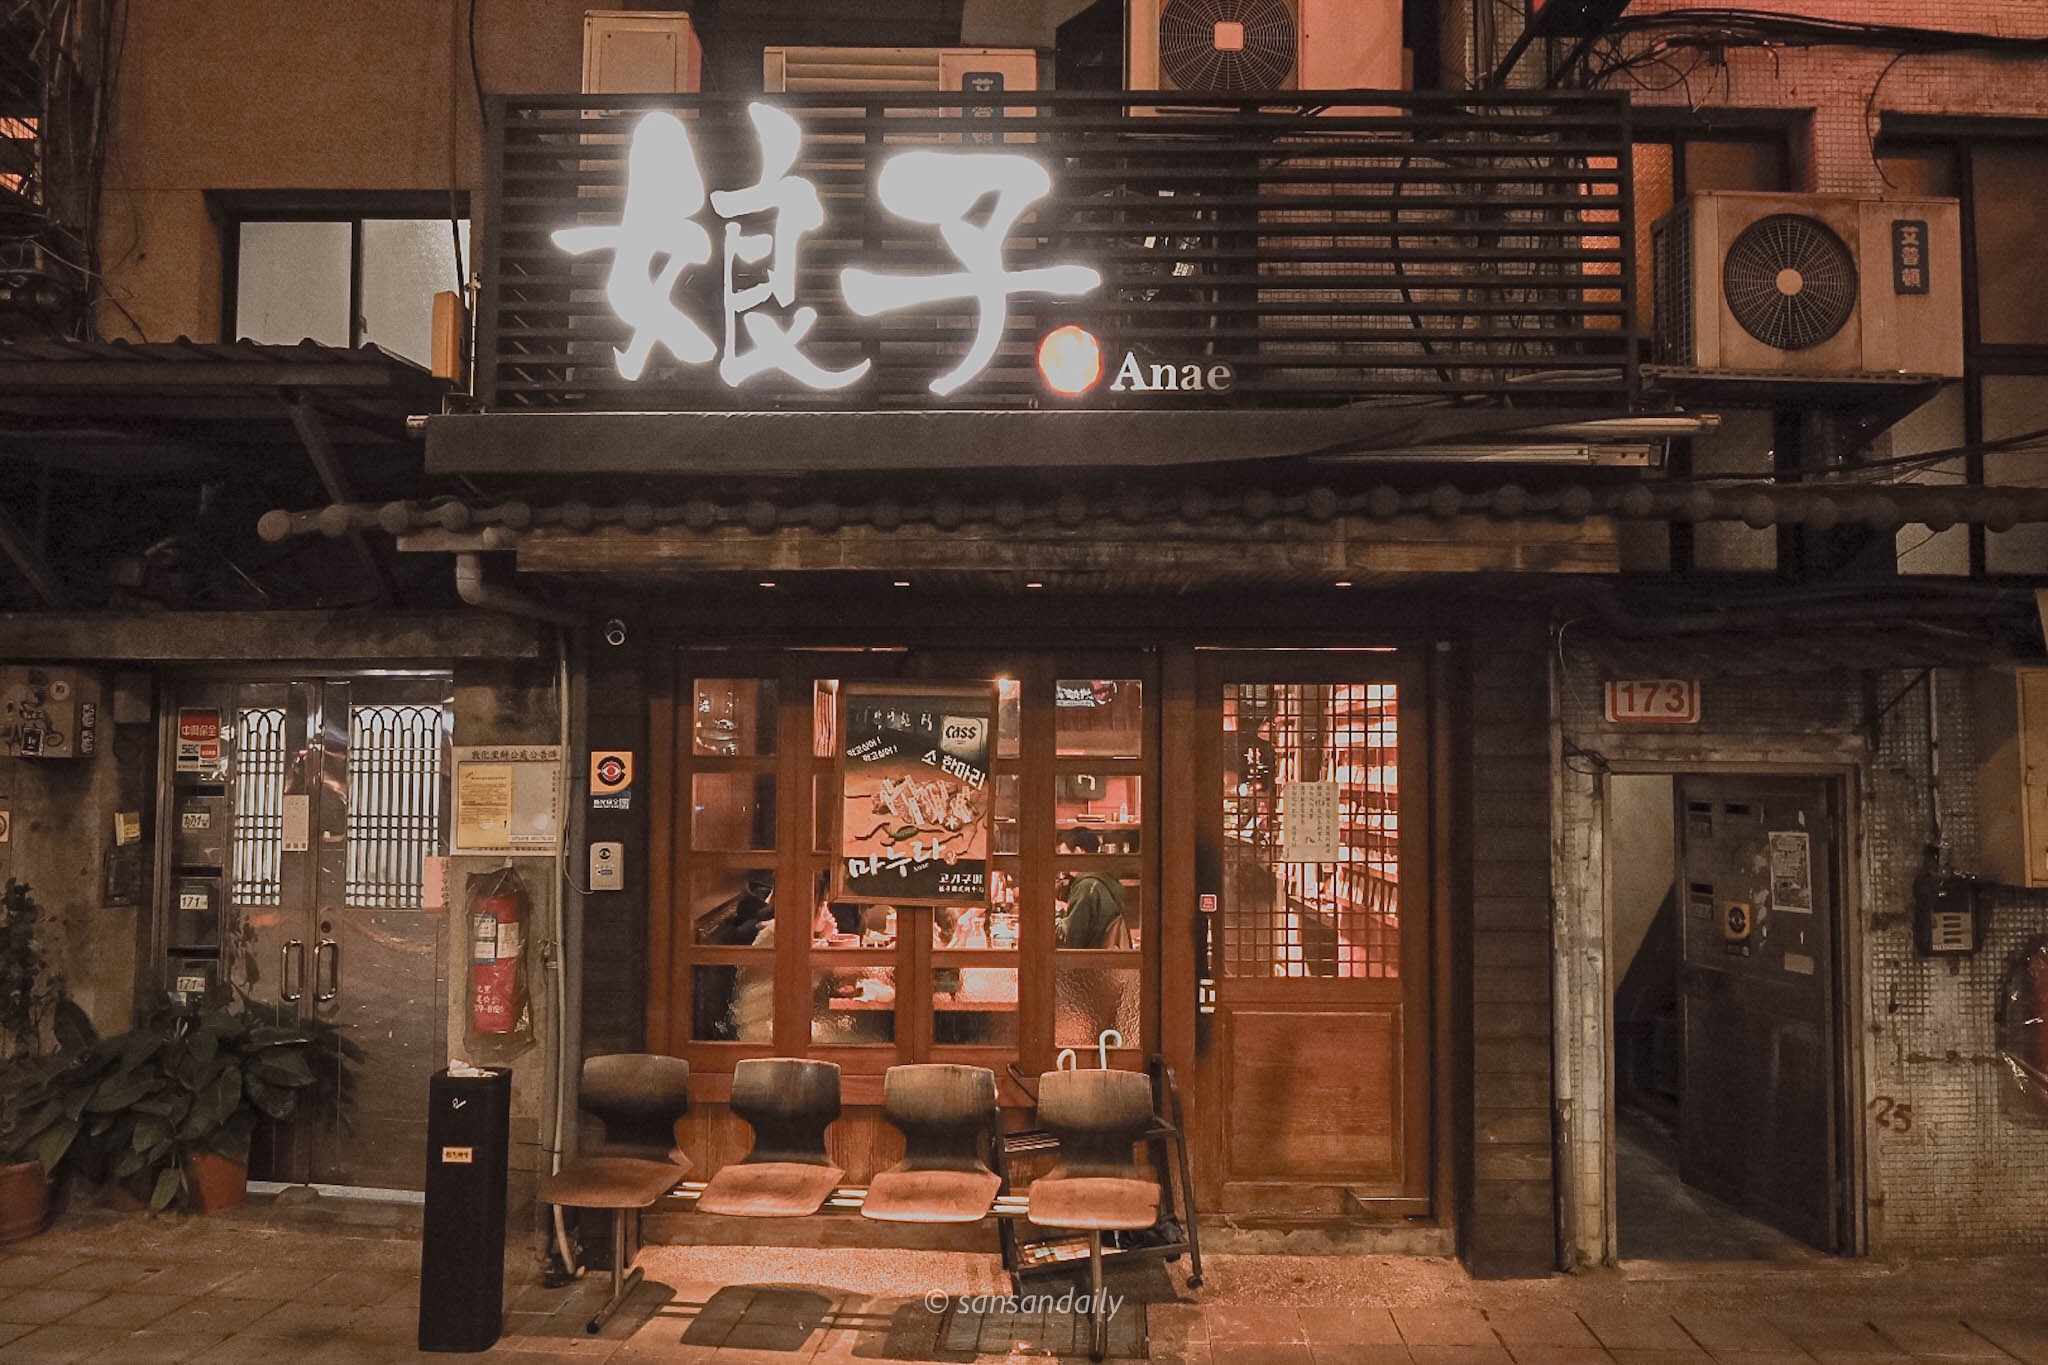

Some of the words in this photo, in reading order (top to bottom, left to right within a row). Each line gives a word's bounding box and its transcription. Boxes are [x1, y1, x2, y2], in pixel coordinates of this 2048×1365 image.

[550, 101, 1101, 396] 娘子
[1900, 225, 1921, 288] 艾普頓
[1109, 350, 1231, 391] Anae
[1620, 682, 1685, 713] 173
[940, 754, 986, 791] 한마리
[848, 837, 947, 879] 마누라
[1868, 1096, 1913, 1134] 25
